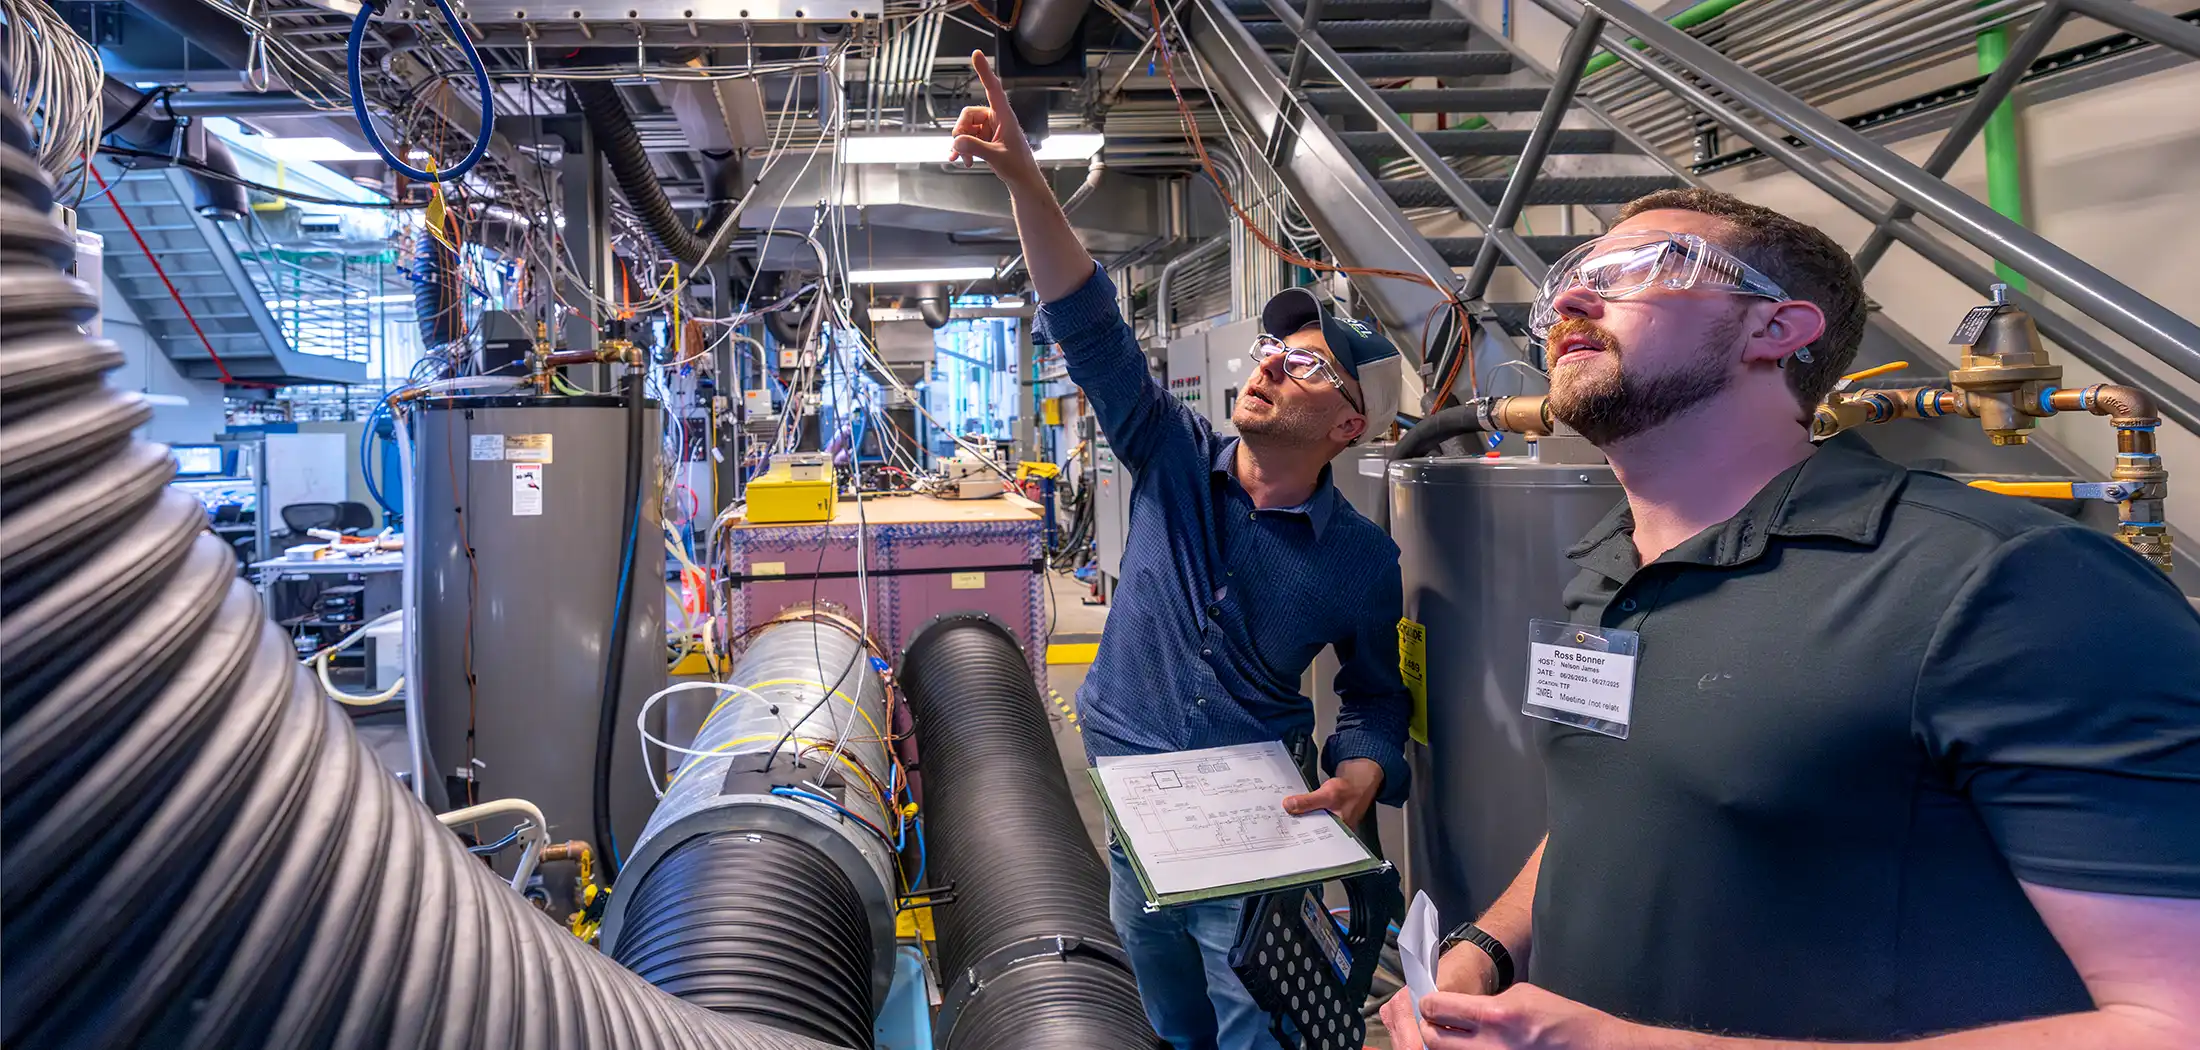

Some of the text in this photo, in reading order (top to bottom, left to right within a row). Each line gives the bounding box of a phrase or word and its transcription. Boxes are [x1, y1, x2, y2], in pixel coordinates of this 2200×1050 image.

[1554, 650, 1606, 665] Ross Bonner
[1560, 662, 1580, 670] Nelson
[1581, 664, 1600, 674] James
